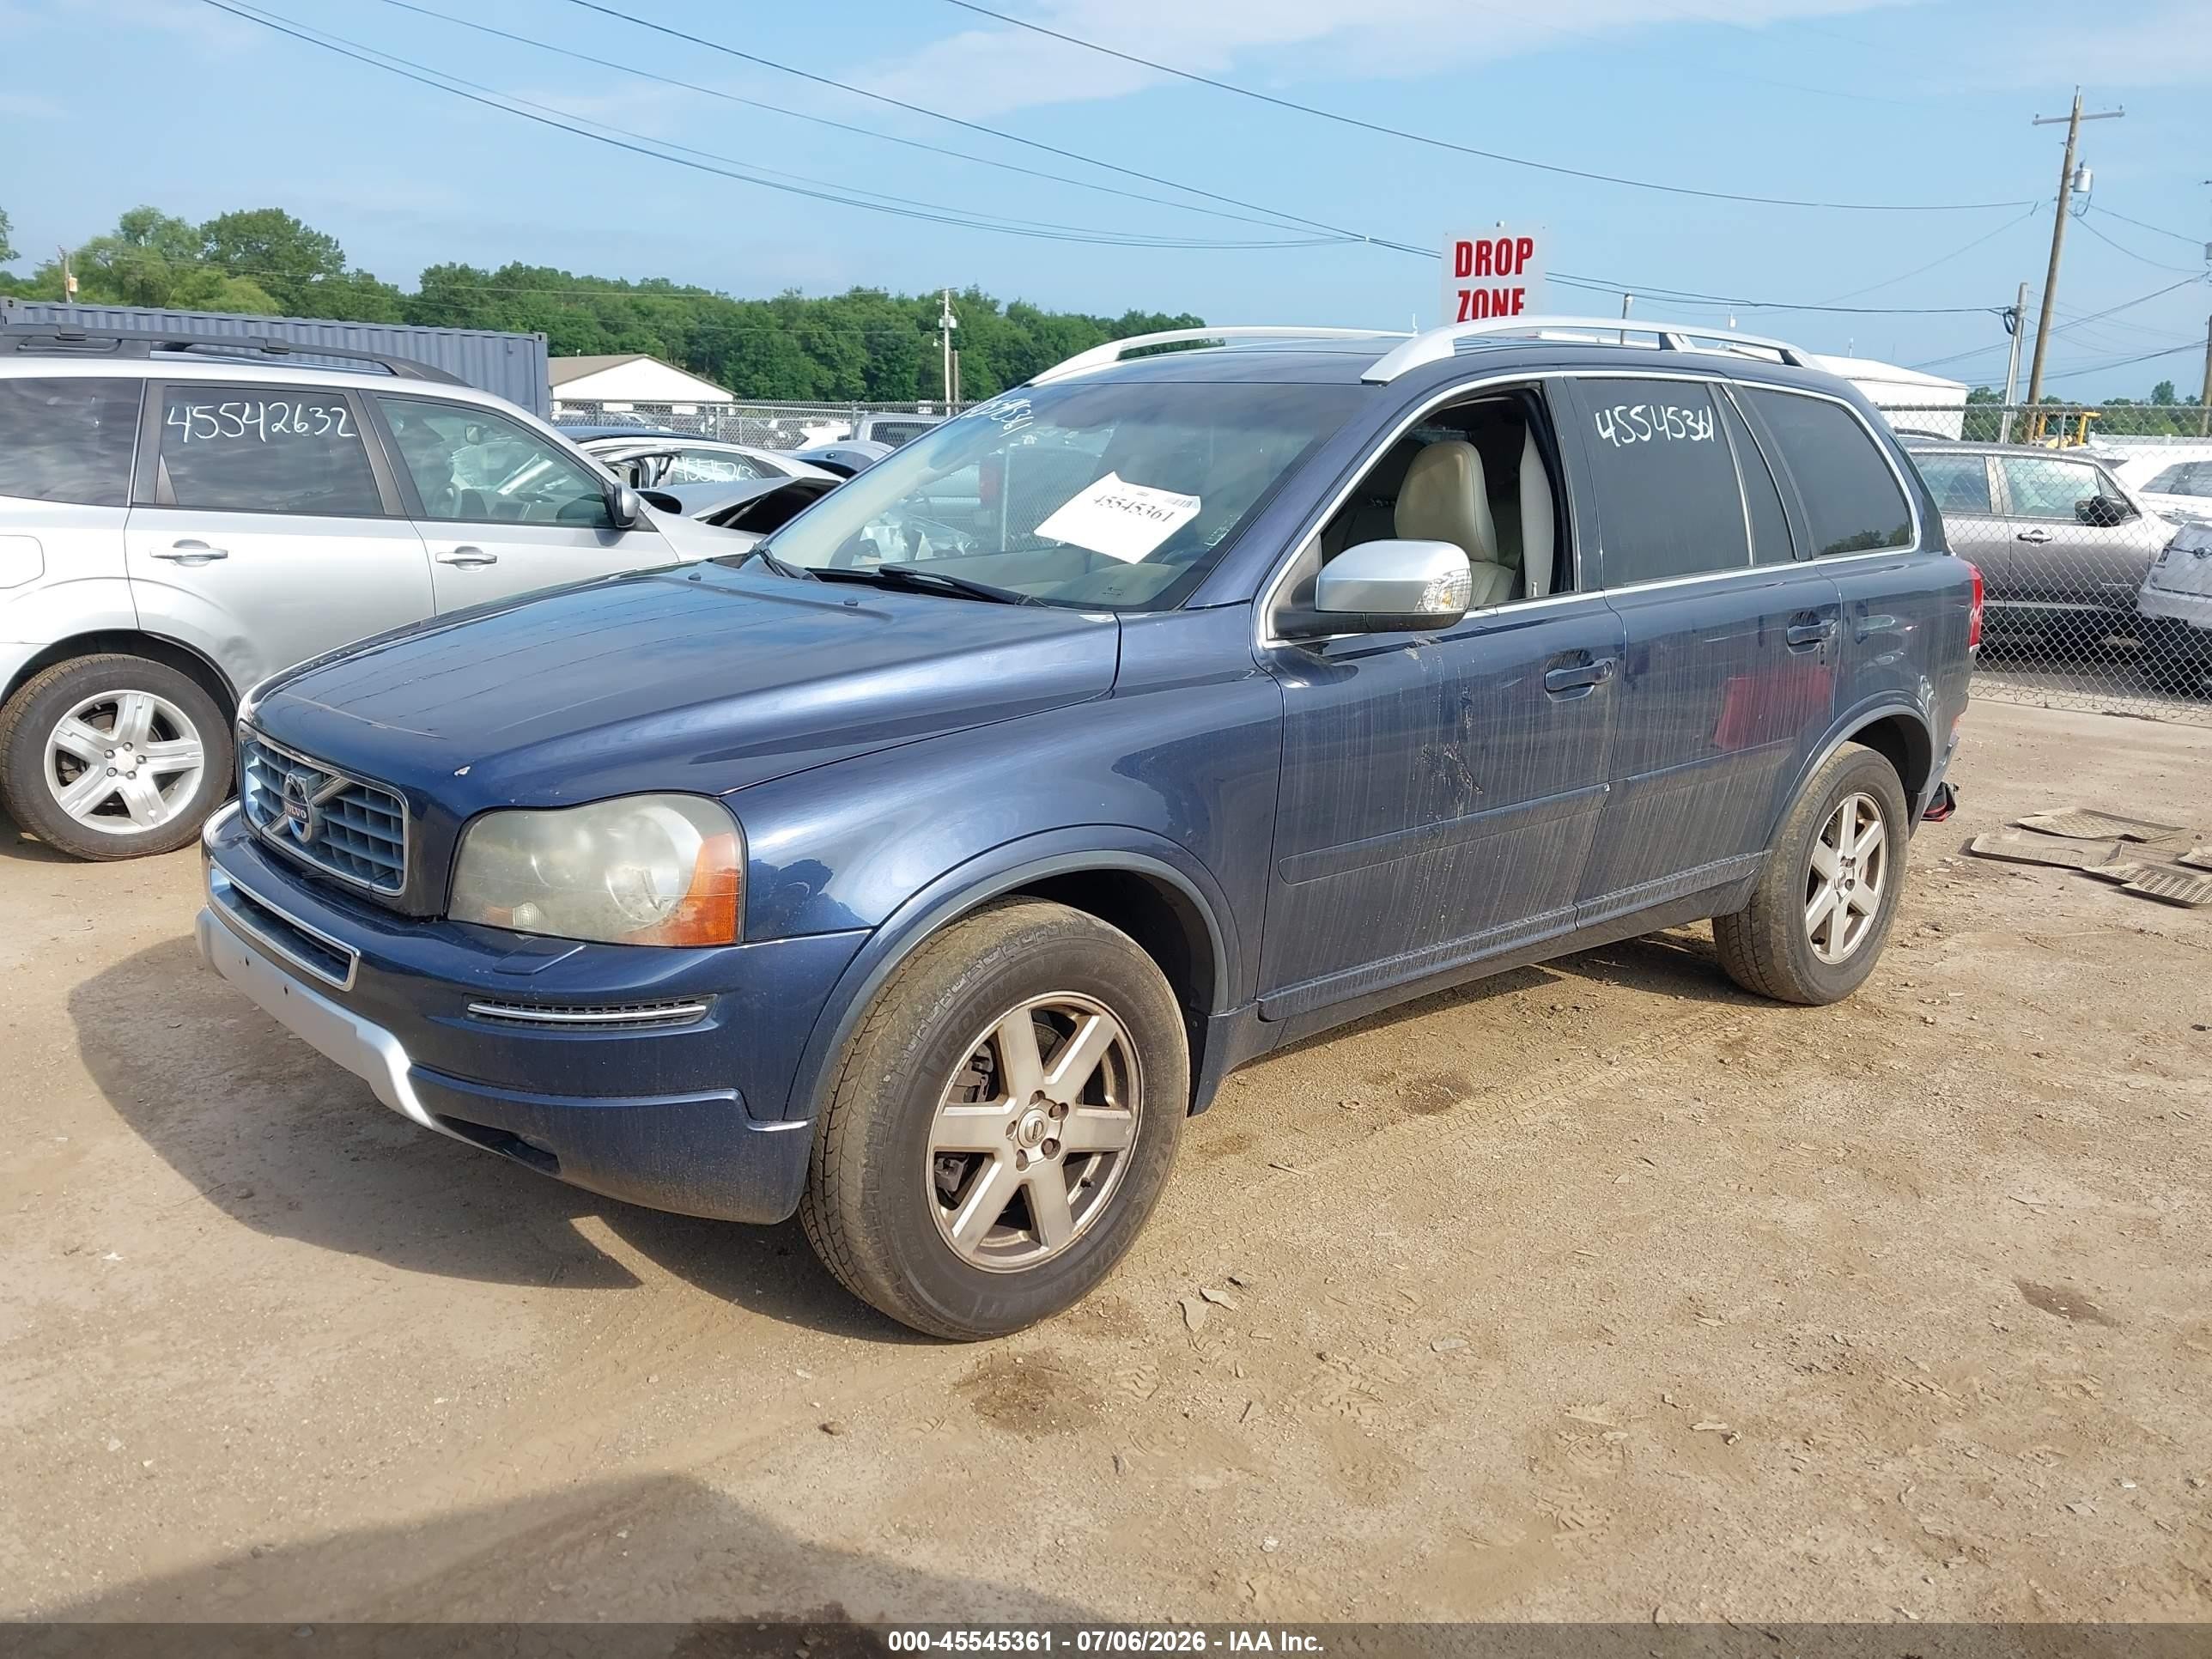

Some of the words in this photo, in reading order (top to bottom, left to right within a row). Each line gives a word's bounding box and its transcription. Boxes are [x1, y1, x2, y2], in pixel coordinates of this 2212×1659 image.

[1455, 237, 1534, 277] DROP
[167, 401, 356, 443] 45542632
[1595, 404, 1715, 447] 45545361
[1093, 495, 1176, 522] 45545361
[284, 801, 307, 819] VOLVO
